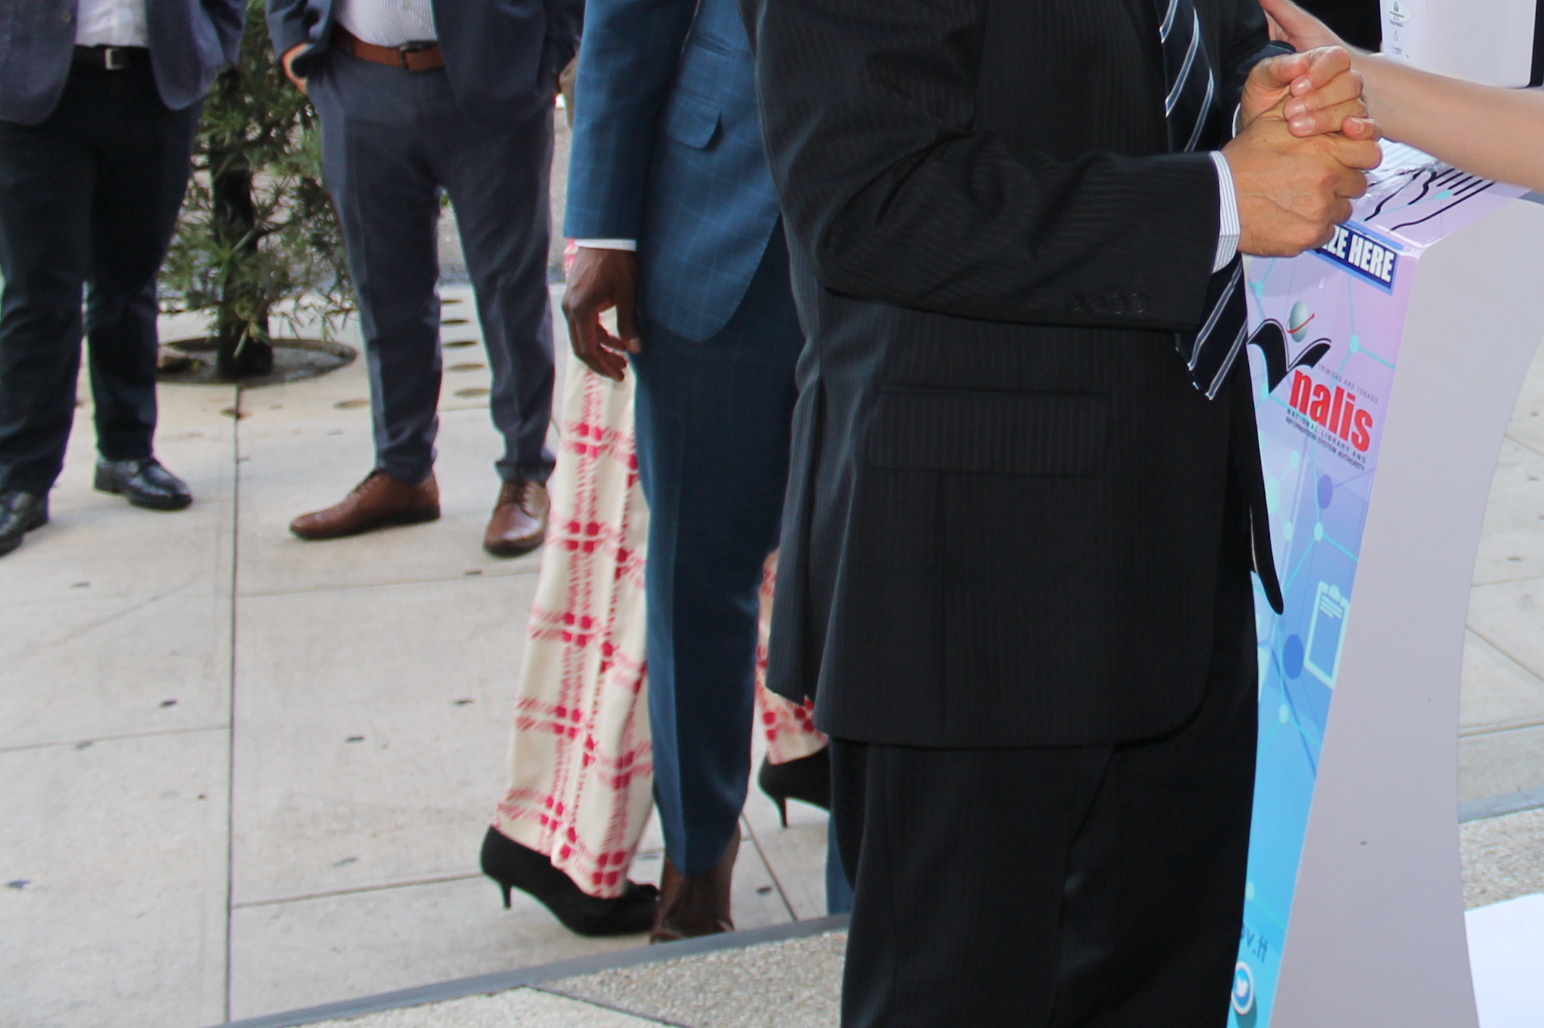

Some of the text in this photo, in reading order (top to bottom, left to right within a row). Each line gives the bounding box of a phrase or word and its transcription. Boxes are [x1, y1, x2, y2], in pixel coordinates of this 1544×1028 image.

[1347, 233, 1395, 283] HERE
[1287, 408, 1367, 464] NATIONAL LIBRARY AND
[1289, 369, 1373, 452] nalis
